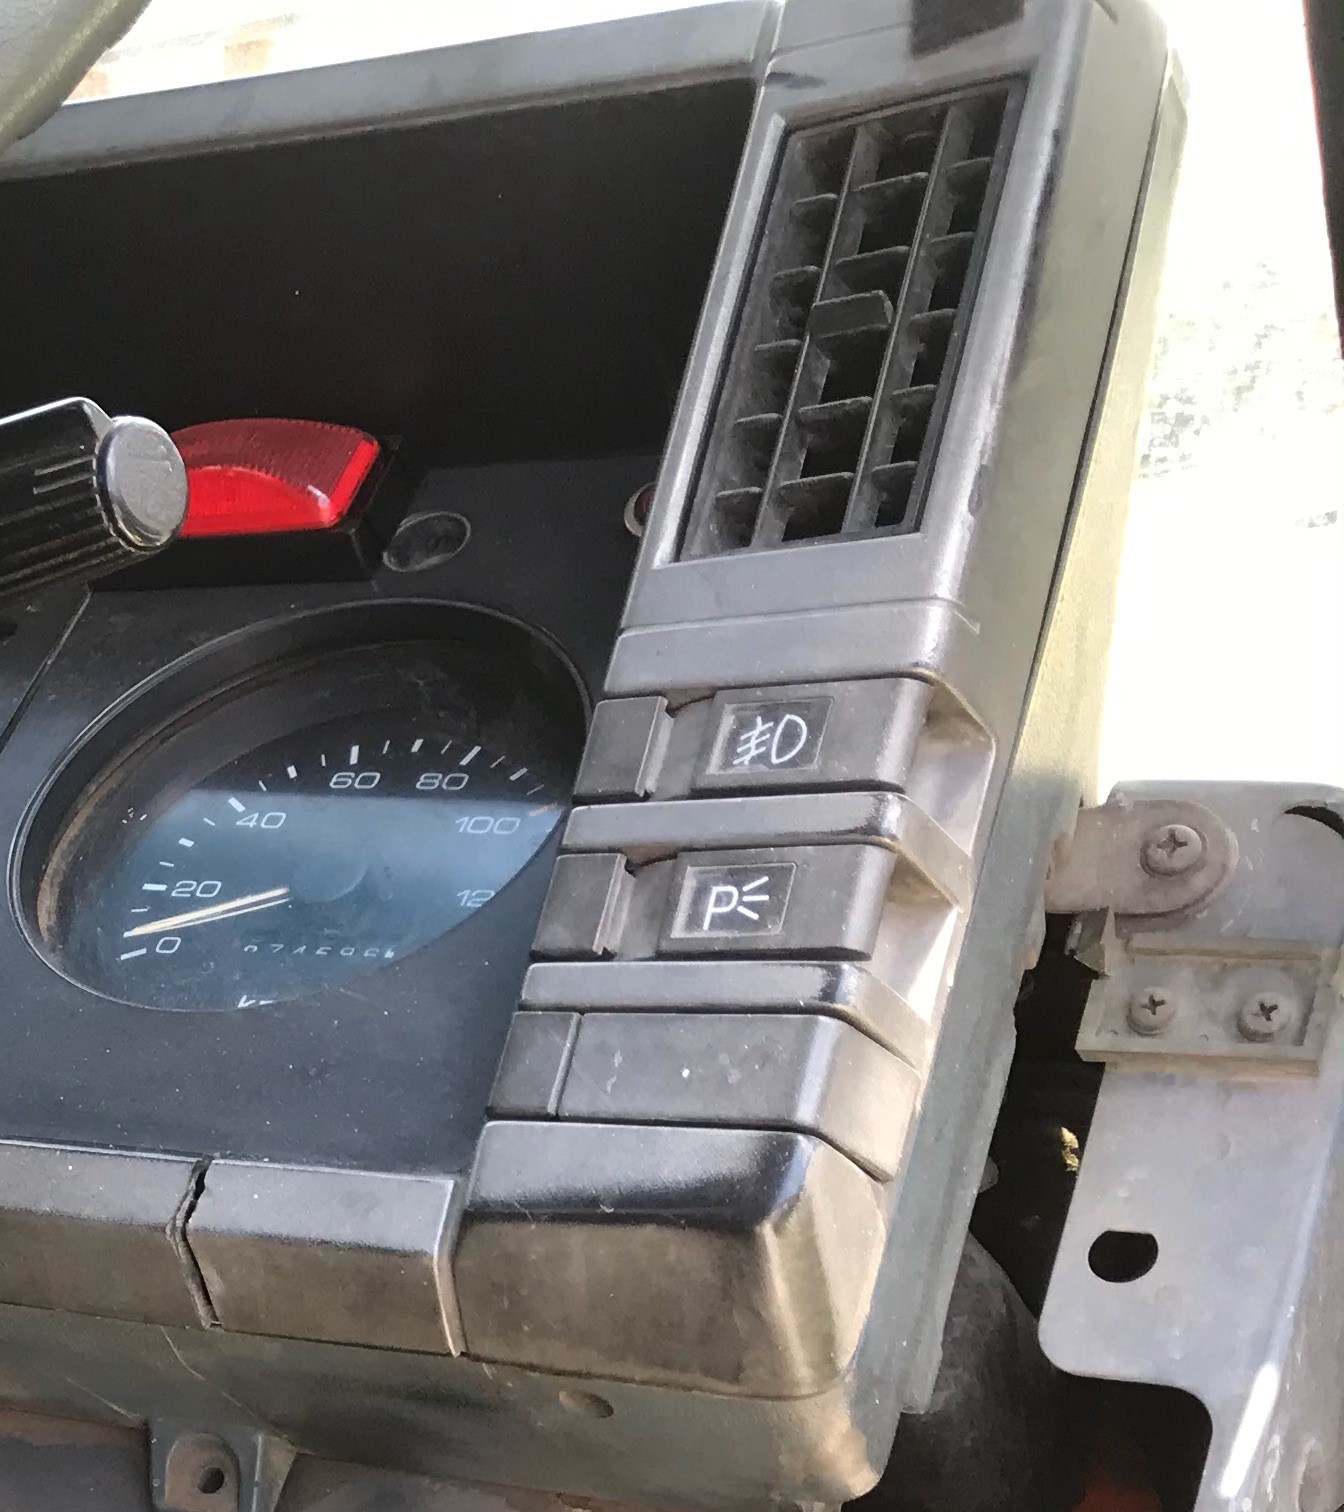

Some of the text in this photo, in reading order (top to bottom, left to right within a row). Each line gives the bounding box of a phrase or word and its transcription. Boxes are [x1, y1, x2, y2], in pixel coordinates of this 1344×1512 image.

[329, 772, 381, 790] 60
[415, 772, 469, 791] 80
[235, 812, 287, 830] 40
[454, 816, 522, 835] 100
[171, 880, 223, 898] 20
[456, 889, 496, 908] 12
[155, 936, 182, 954] 0
